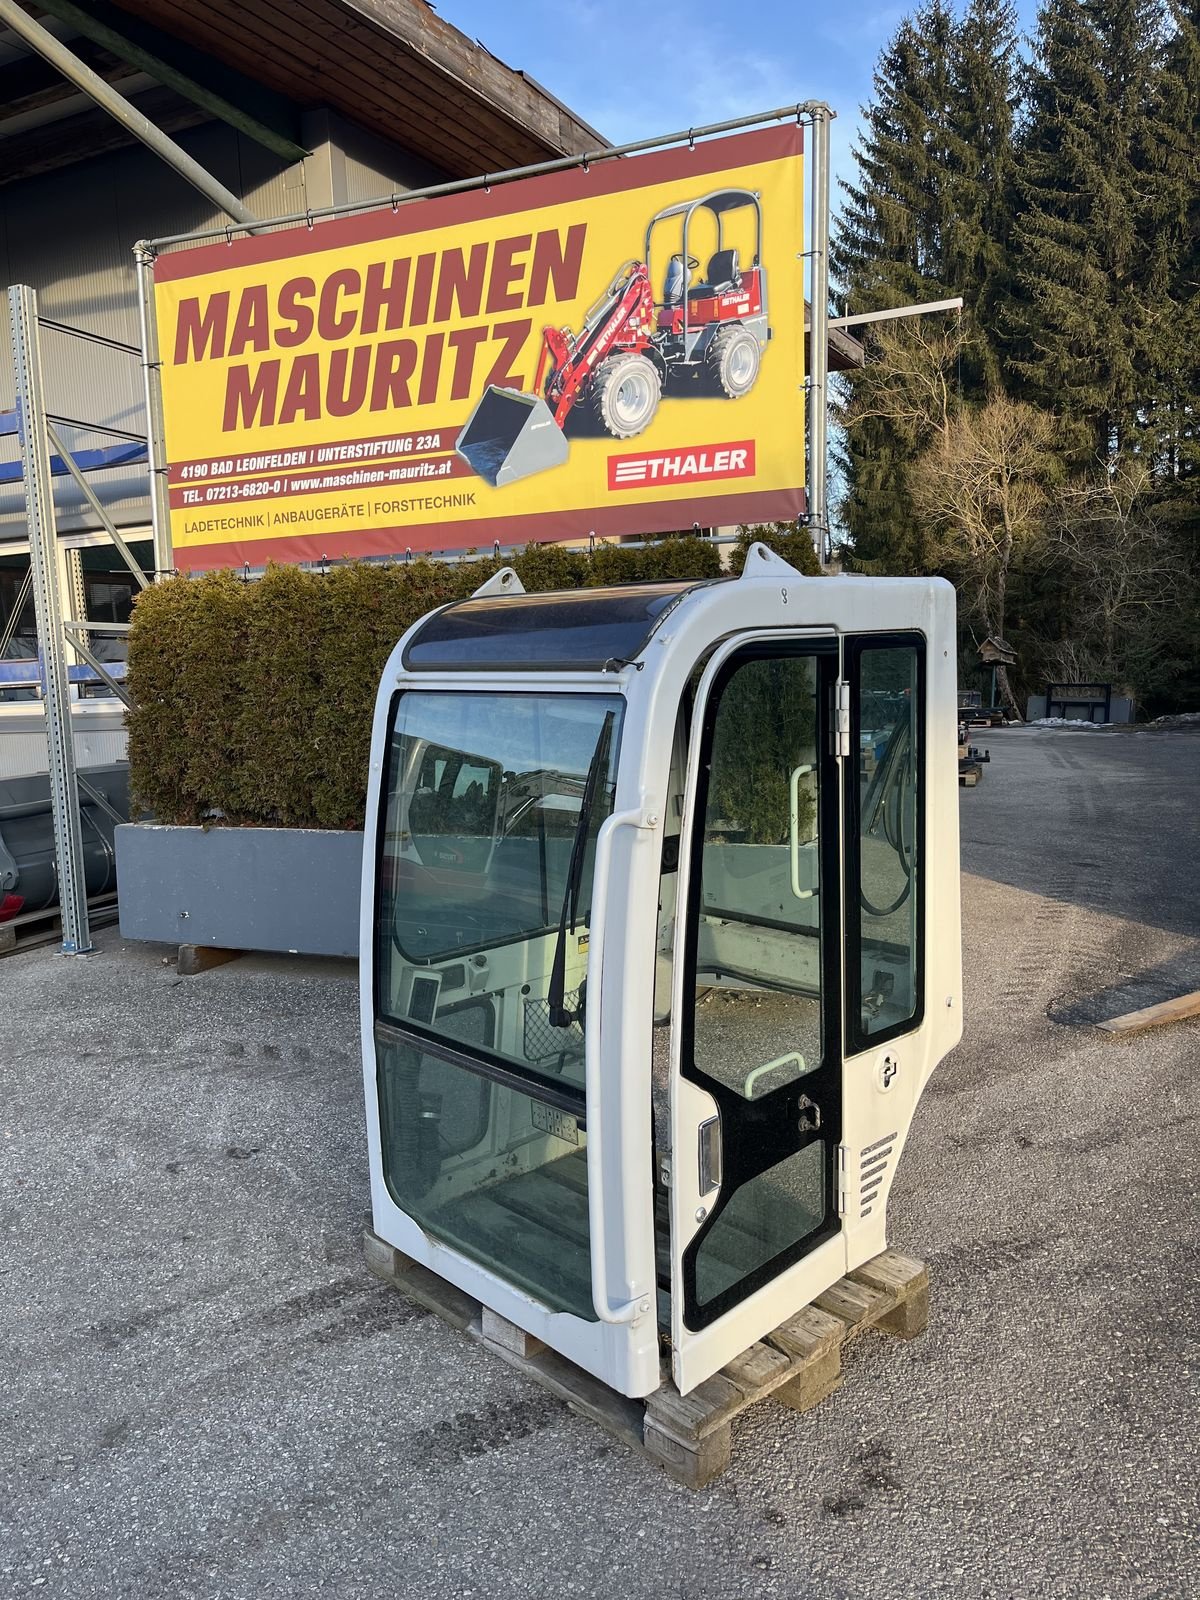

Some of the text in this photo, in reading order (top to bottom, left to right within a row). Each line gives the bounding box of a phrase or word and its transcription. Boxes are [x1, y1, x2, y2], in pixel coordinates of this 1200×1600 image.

[173, 223, 587, 365] MASCHINEN
[222, 318, 532, 432] MAURITZ
[181, 464, 208, 479] 4190
[211, 462, 233, 476] BAD
[236, 451, 307, 473] LEONFELDEN
[317, 438, 413, 462] UNTERSTIFTUNG
[416, 434, 441, 450] 23A
[647, 449, 748, 479] THALER
[183, 489, 203, 504] TEL.
[206, 480, 281, 501] 07213-6820-0
[291, 460, 452, 491] www.maschinen-mauritz.at
[185, 514, 264, 534] LADETECHNIK
[273, 503, 365, 525] ANBAUGERÄTE
[374, 493, 476, 515] FORSTTECHNIK
